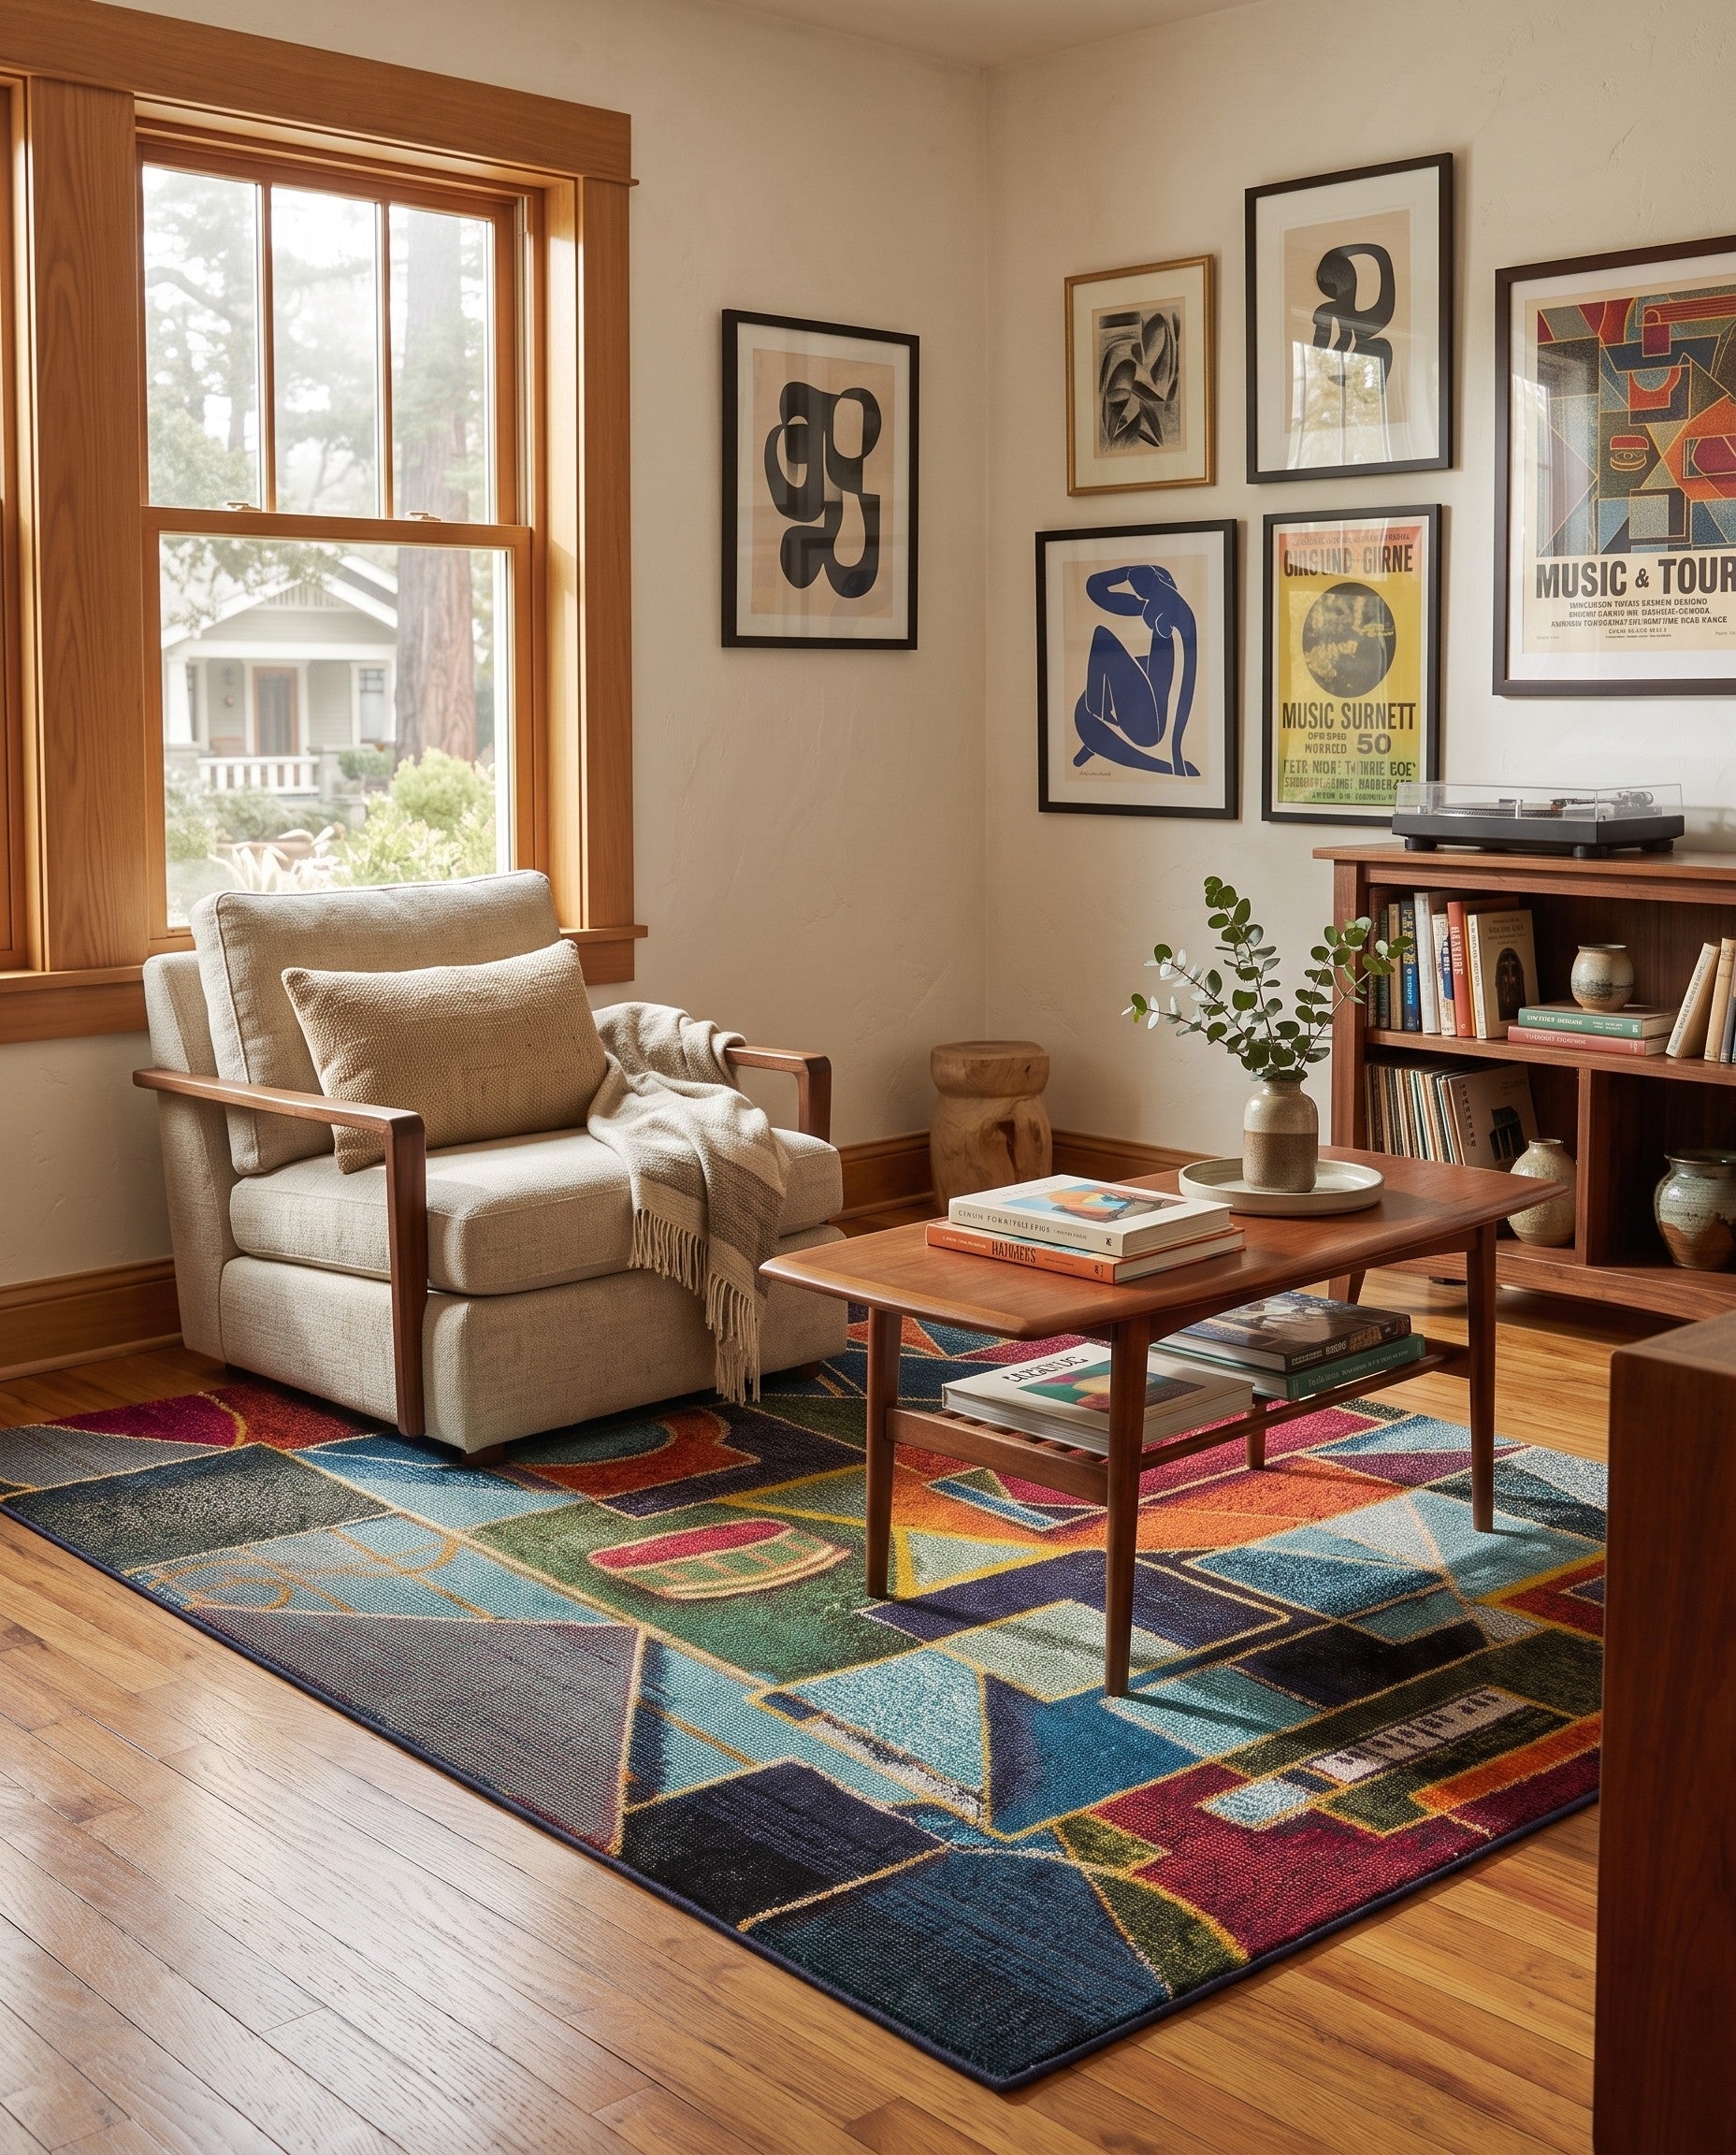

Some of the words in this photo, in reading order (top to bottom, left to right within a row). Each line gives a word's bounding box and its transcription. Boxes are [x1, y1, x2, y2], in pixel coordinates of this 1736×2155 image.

[1536, 560, 1628, 599] MUSIC
[1635, 568, 1650, 588] &
[1657, 556, 1736, 595] TOUR
[1282, 702, 1335, 730] MUSIC
[1340, 702, 1416, 730] SURNETT
[1356, 733, 1392, 755] 50
